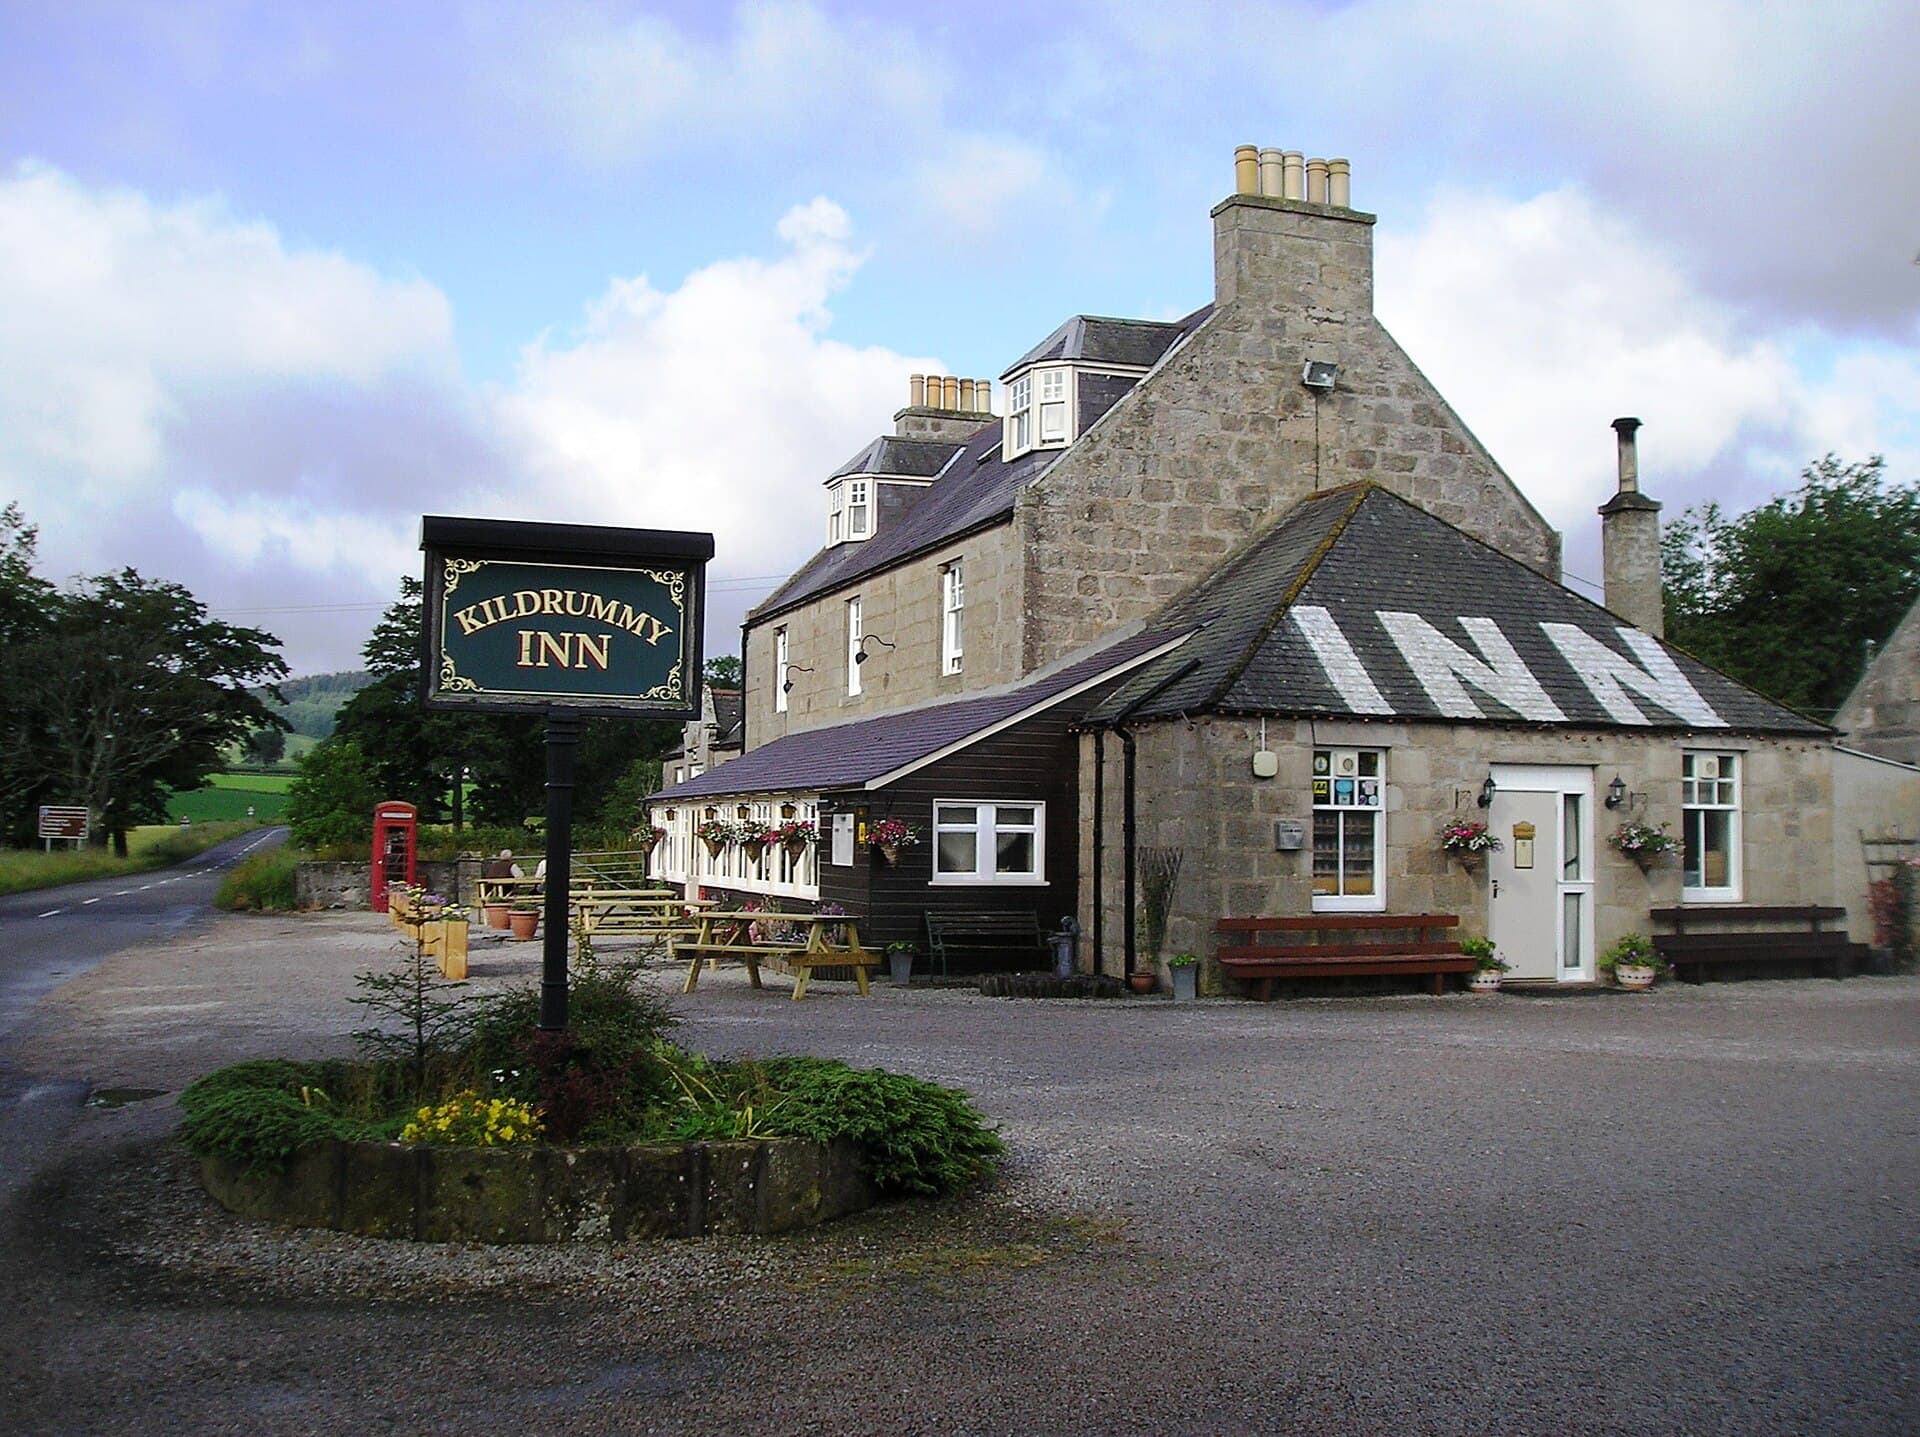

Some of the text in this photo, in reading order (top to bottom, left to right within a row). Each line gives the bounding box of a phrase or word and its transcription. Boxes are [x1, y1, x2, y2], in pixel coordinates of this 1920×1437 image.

[454, 589, 673, 647] KILDRUMMY
[517, 630, 612, 671] INN
[1290, 606, 1730, 727] INN
